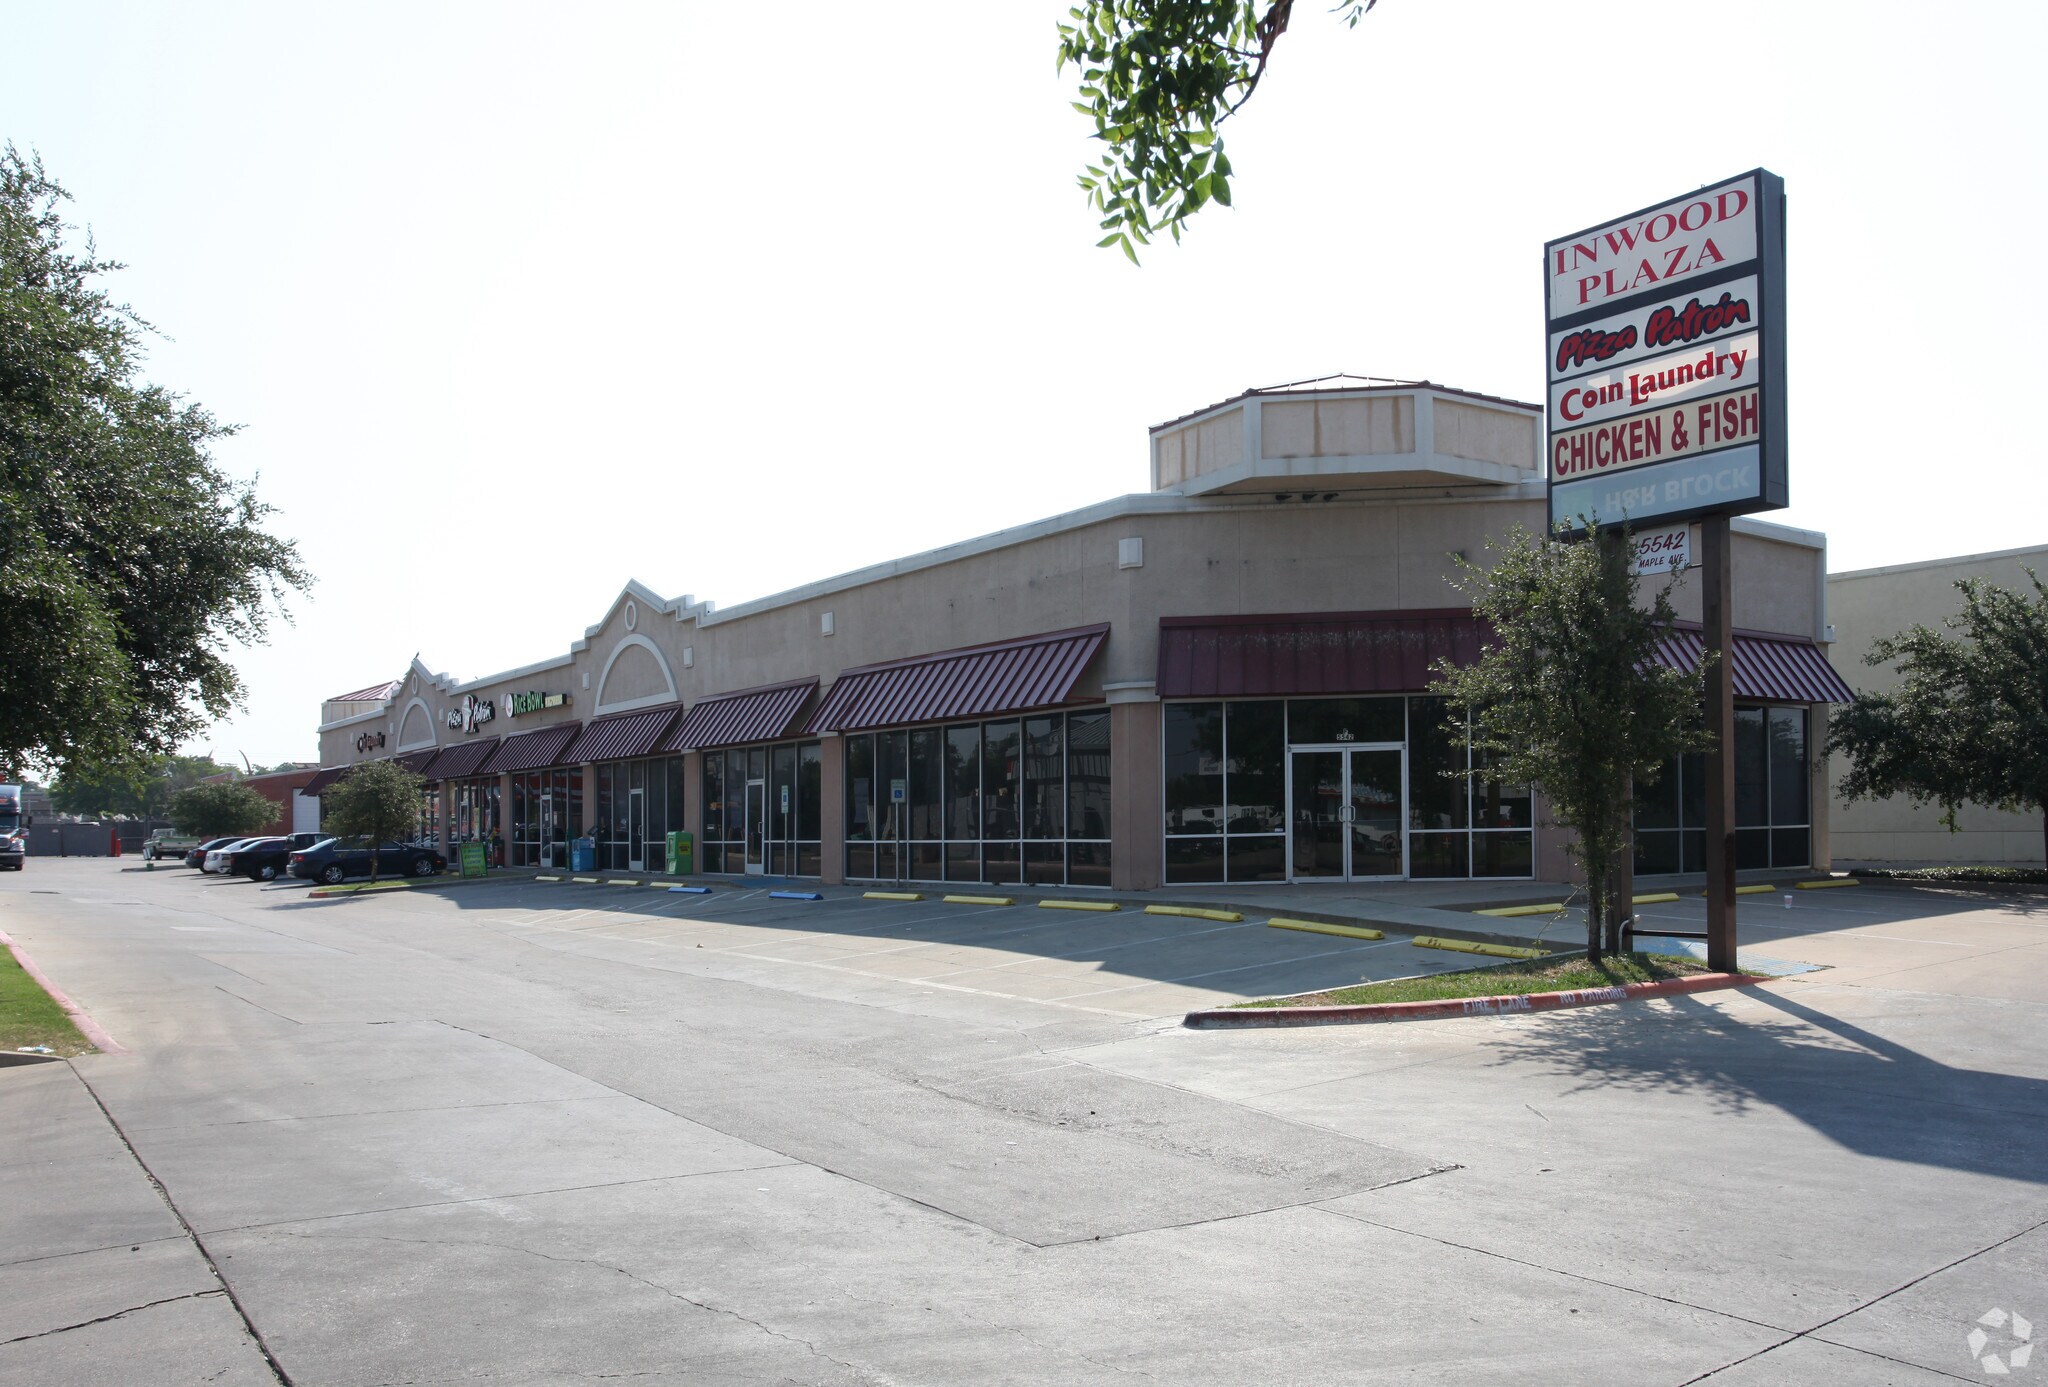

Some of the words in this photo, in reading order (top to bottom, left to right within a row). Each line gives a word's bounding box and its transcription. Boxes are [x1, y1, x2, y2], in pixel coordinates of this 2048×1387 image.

[1554, 190, 1748, 276] INWOOD
[1577, 238, 1726, 305] PLAZA
[1556, 325, 1637, 372] Pizza
[1645, 292, 1751, 348] Patrón
[1560, 381, 1624, 421] Coin
[1629, 349, 1747, 406] Laundry
[1555, 416, 1661, 476] CHICKEN
[1671, 410, 1689, 451] &
[1698, 393, 1758, 446] FISH
[1638, 556, 1664, 568] MAPLE
[1639, 531, 1685, 554] 5542
[527, 691, 544, 711] BOWL
[1463, 1000, 1489, 1013] FIRE
[1498, 995, 1531, 1011] LANE
[1560, 992, 1576, 1004] NO
